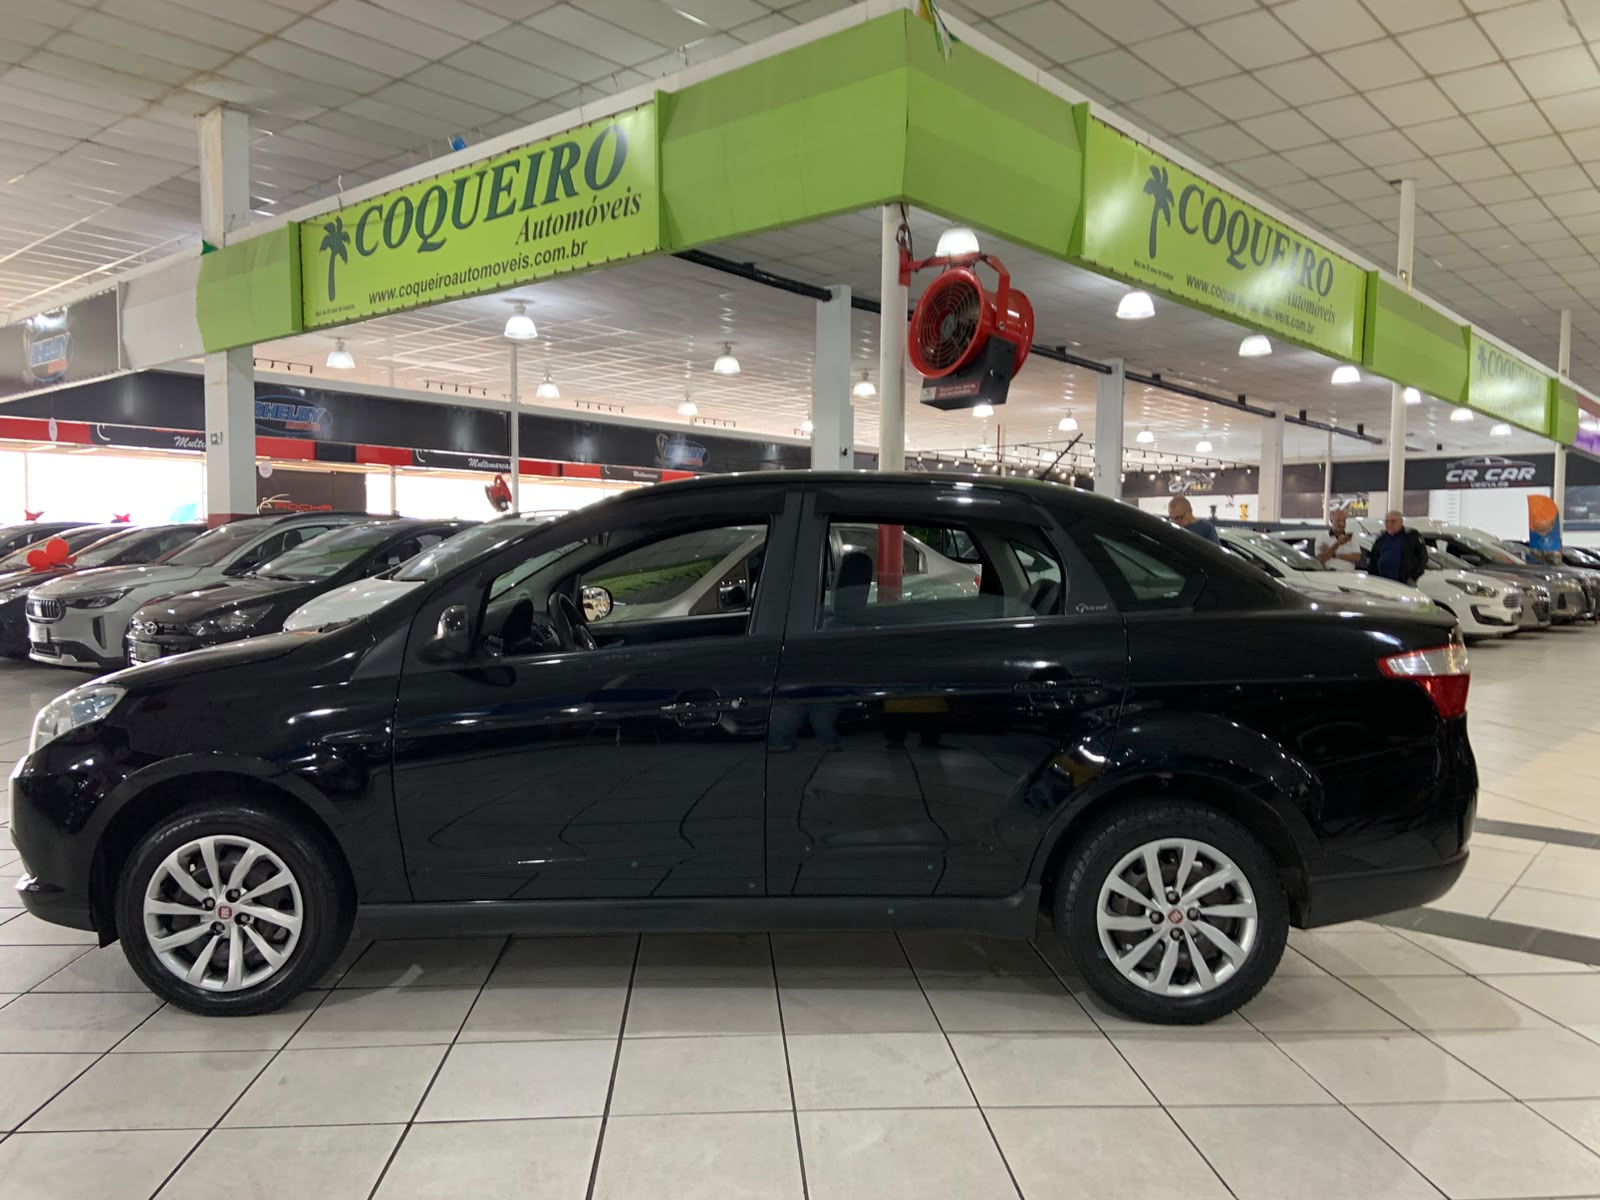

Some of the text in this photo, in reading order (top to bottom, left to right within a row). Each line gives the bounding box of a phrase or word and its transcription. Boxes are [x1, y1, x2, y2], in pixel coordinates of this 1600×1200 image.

[355, 124, 628, 254] COQUEIRO
[514, 185, 643, 246] Automóveis
[367, 237, 589, 305] www.coqueiroautomoveis.com.br
[1178, 184, 1334, 298] COQUEIRO
[1445, 466, 1537, 482] CR CAR
